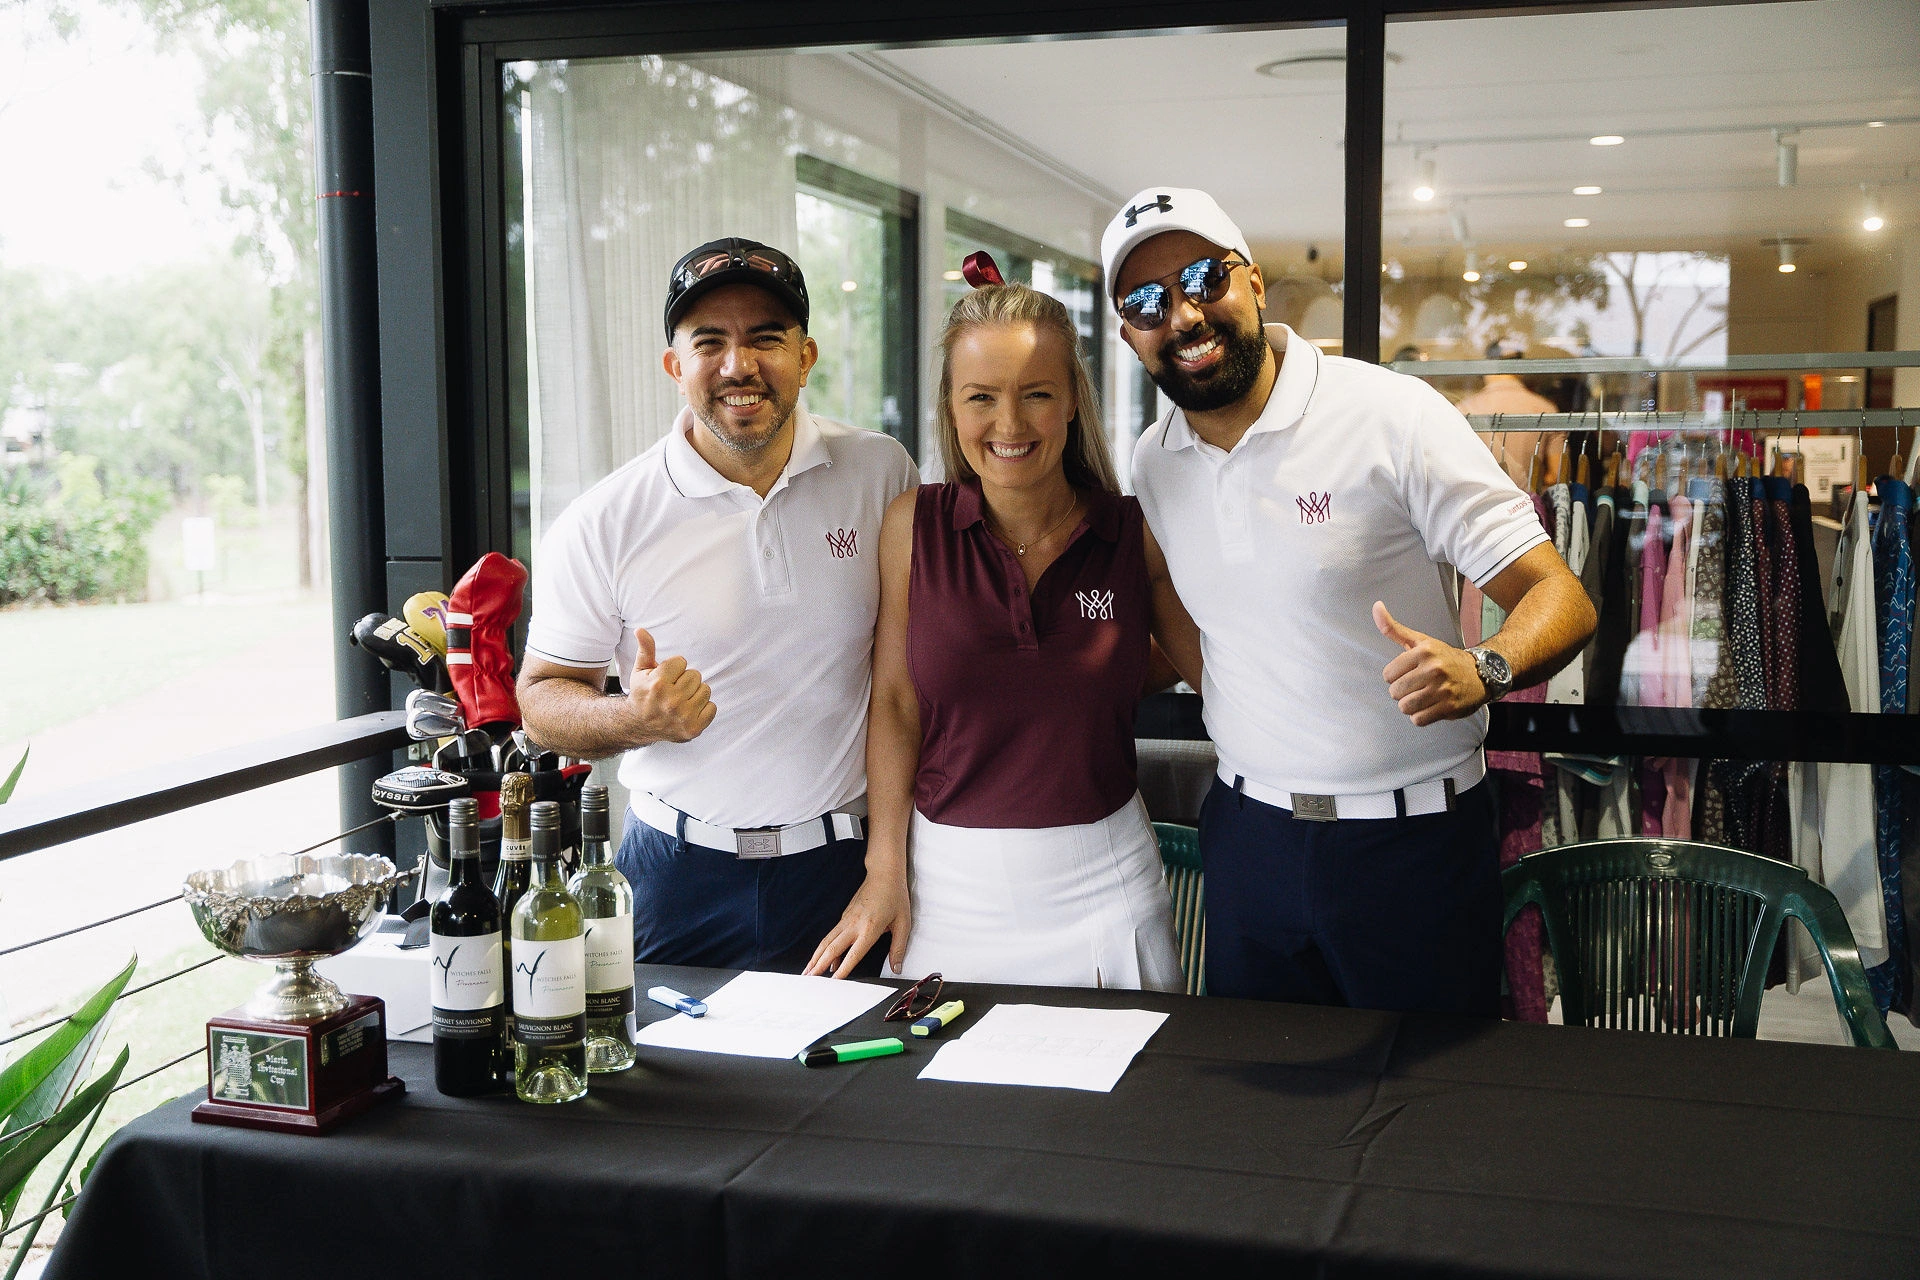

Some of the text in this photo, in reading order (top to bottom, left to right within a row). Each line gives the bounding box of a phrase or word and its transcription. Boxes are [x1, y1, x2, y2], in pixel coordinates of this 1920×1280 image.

[372, 788, 421, 802] DYSSEY
[600, 996, 620, 1004] BLANC
[455, 1016, 492, 1025] SAUVIGNON
[518, 1022, 573, 1031] SAUVIGNON BLANC
[270, 1075, 286, 1086] Cup
